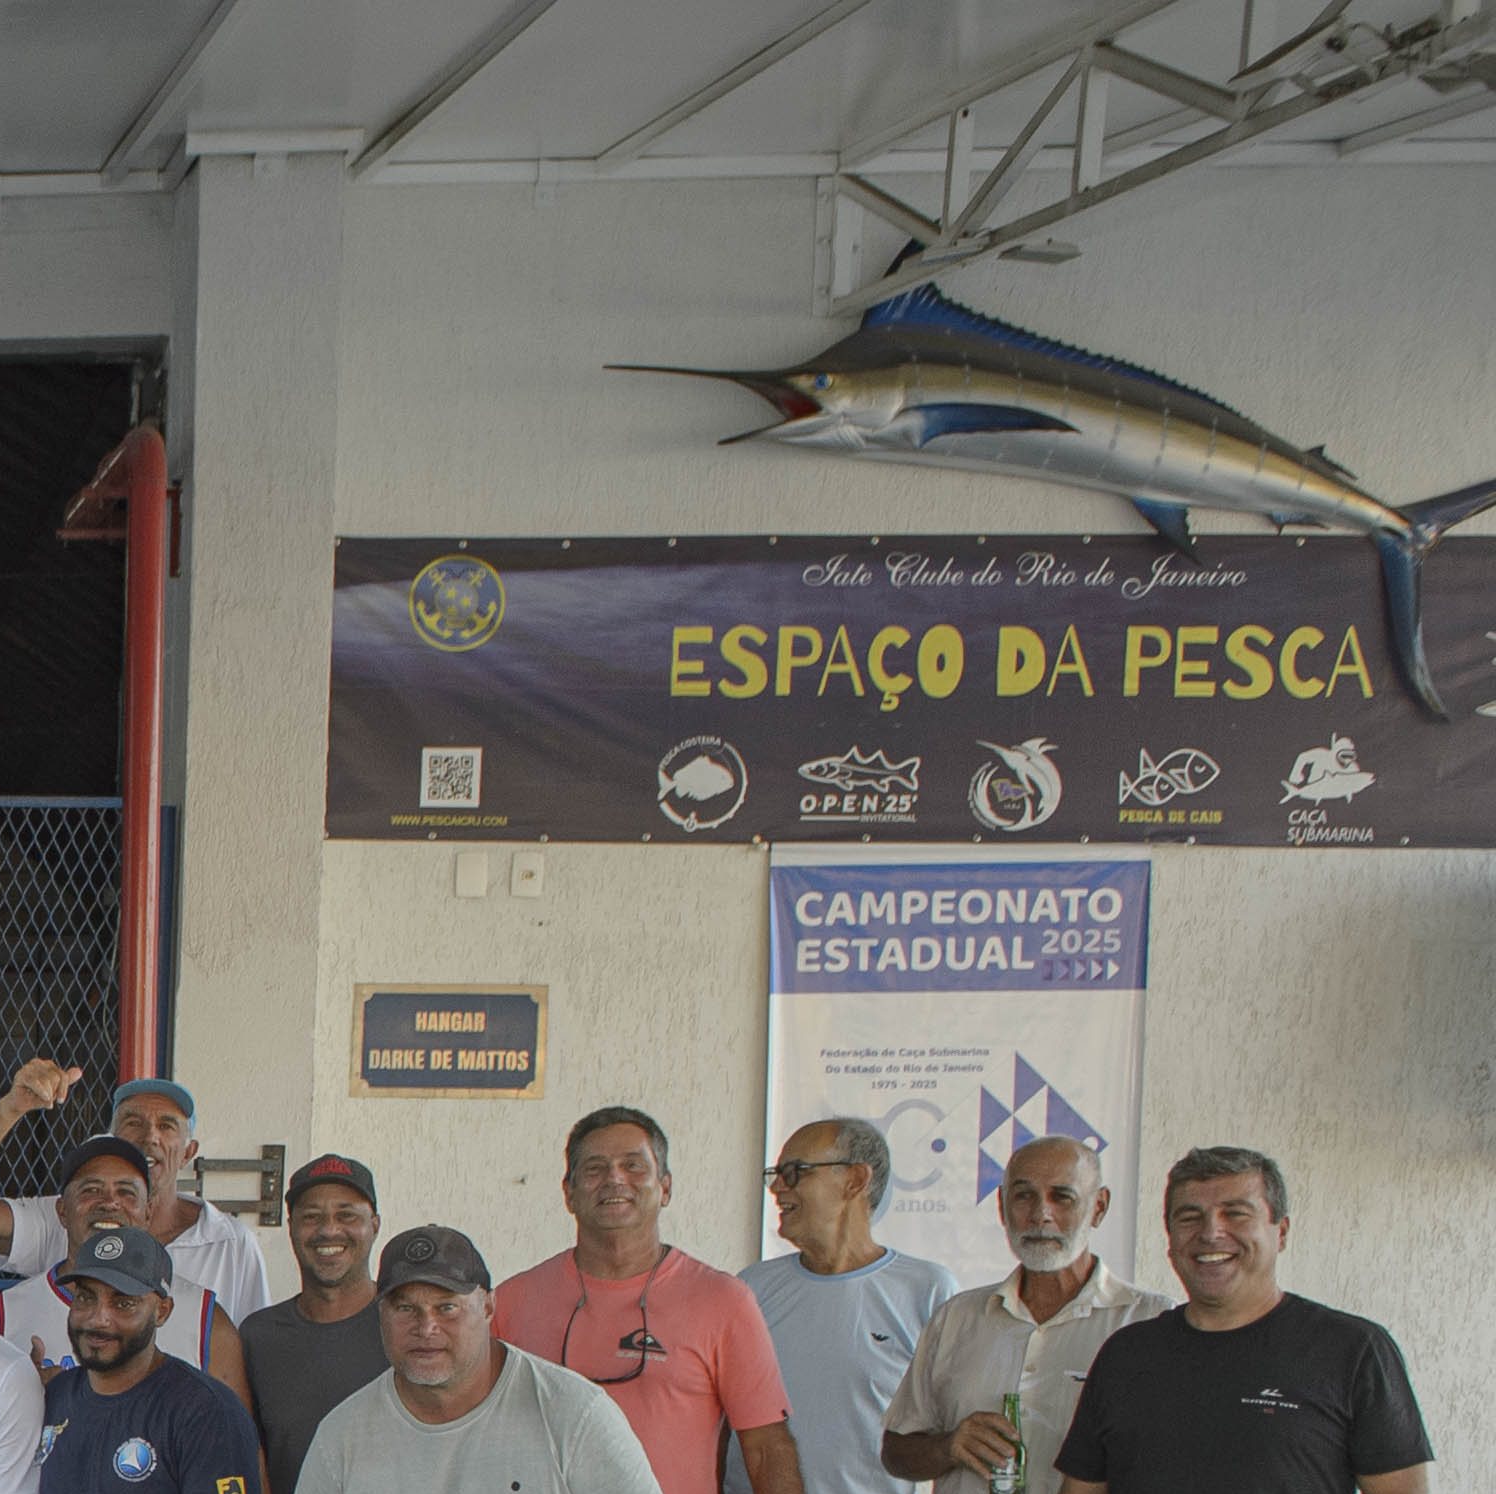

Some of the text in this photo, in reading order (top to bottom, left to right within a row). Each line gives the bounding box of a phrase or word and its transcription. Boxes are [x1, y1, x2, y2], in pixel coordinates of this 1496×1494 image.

[886, 552, 964, 589] Clube
[971, 557, 1003, 587] do
[1015, 552, 1077, 587] Rio
[1084, 557, 1114, 587] de
[1121, 551, 1248, 600] Janeiro
[670, 625, 1374, 712] ESPAÇO DA PESCA
[1119, 810, 1163, 824] PESCA
[1168, 810, 1185, 824] DE
[1288, 810, 1327, 828] CAÇA
[1287, 826, 1374, 843] SUBMARINA
[795, 889, 1122, 926] CAMPEONATO
[796, 929, 1122, 972] ESTADUAL 2025
[416, 1011, 486, 1031] HANGAR
[369, 1050, 529, 1070] DARKE DE MATTOS
[820, 1047, 990, 1059] Federação de Caça Submarina
[825, 1064, 984, 1074] Do Estado do Rio de Janeiro
[871, 1080, 937, 1089] 1975 2025
